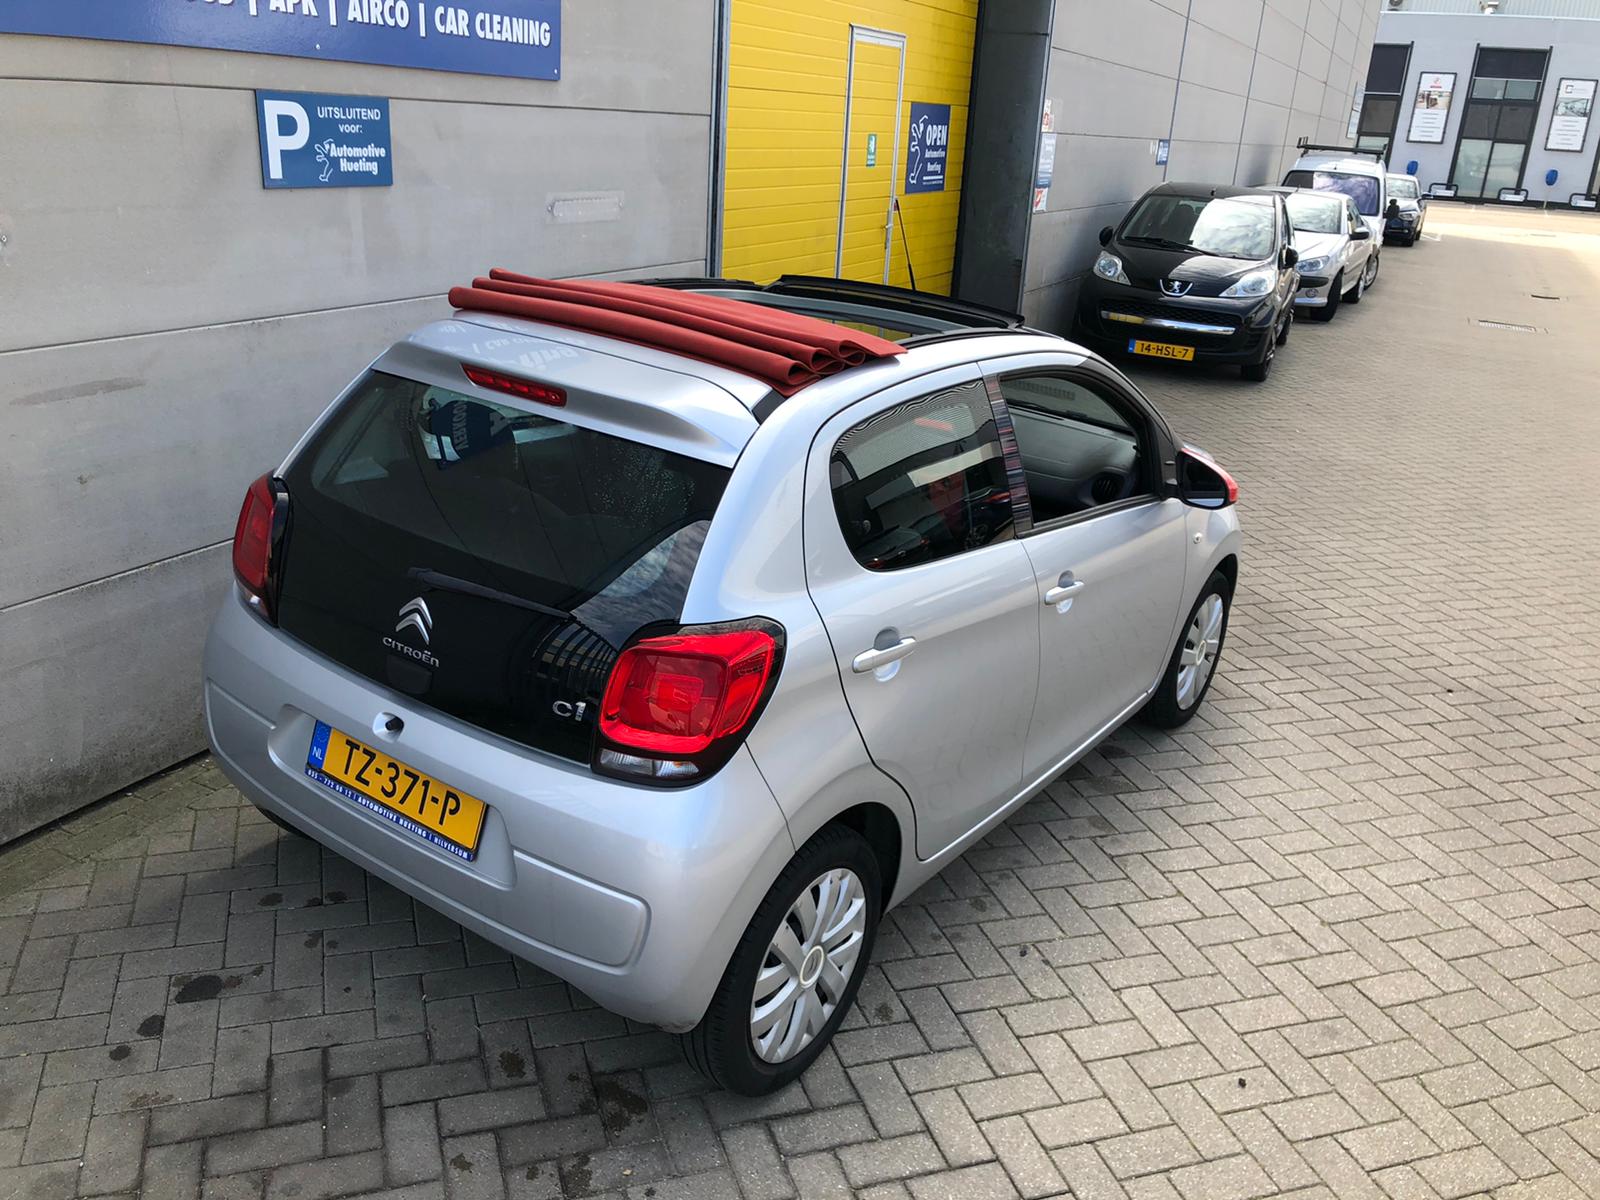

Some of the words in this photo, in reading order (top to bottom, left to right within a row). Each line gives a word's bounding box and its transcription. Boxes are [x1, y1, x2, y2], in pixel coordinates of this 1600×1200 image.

[347, 0, 409, 28] AIRCO
[434, 6, 470, 37] CAR
[475, 12, 551, 47] CLEANING
[317, 106, 381, 120] UITSLUITEND
[338, 123, 363, 133] voor:
[925, 124, 948, 146] OPEN
[263, 99, 310, 179] P
[329, 143, 386, 157] Automotive
[340, 158, 378, 175] Hueting
[1140, 342, 1189, 358] 14-HSL-7
[552, 700, 587, 722] C1
[311, 745, 323, 761] NL
[344, 738, 462, 826] TZ-371-P
[358, 796, 397, 822] AUTOMOTIVE
